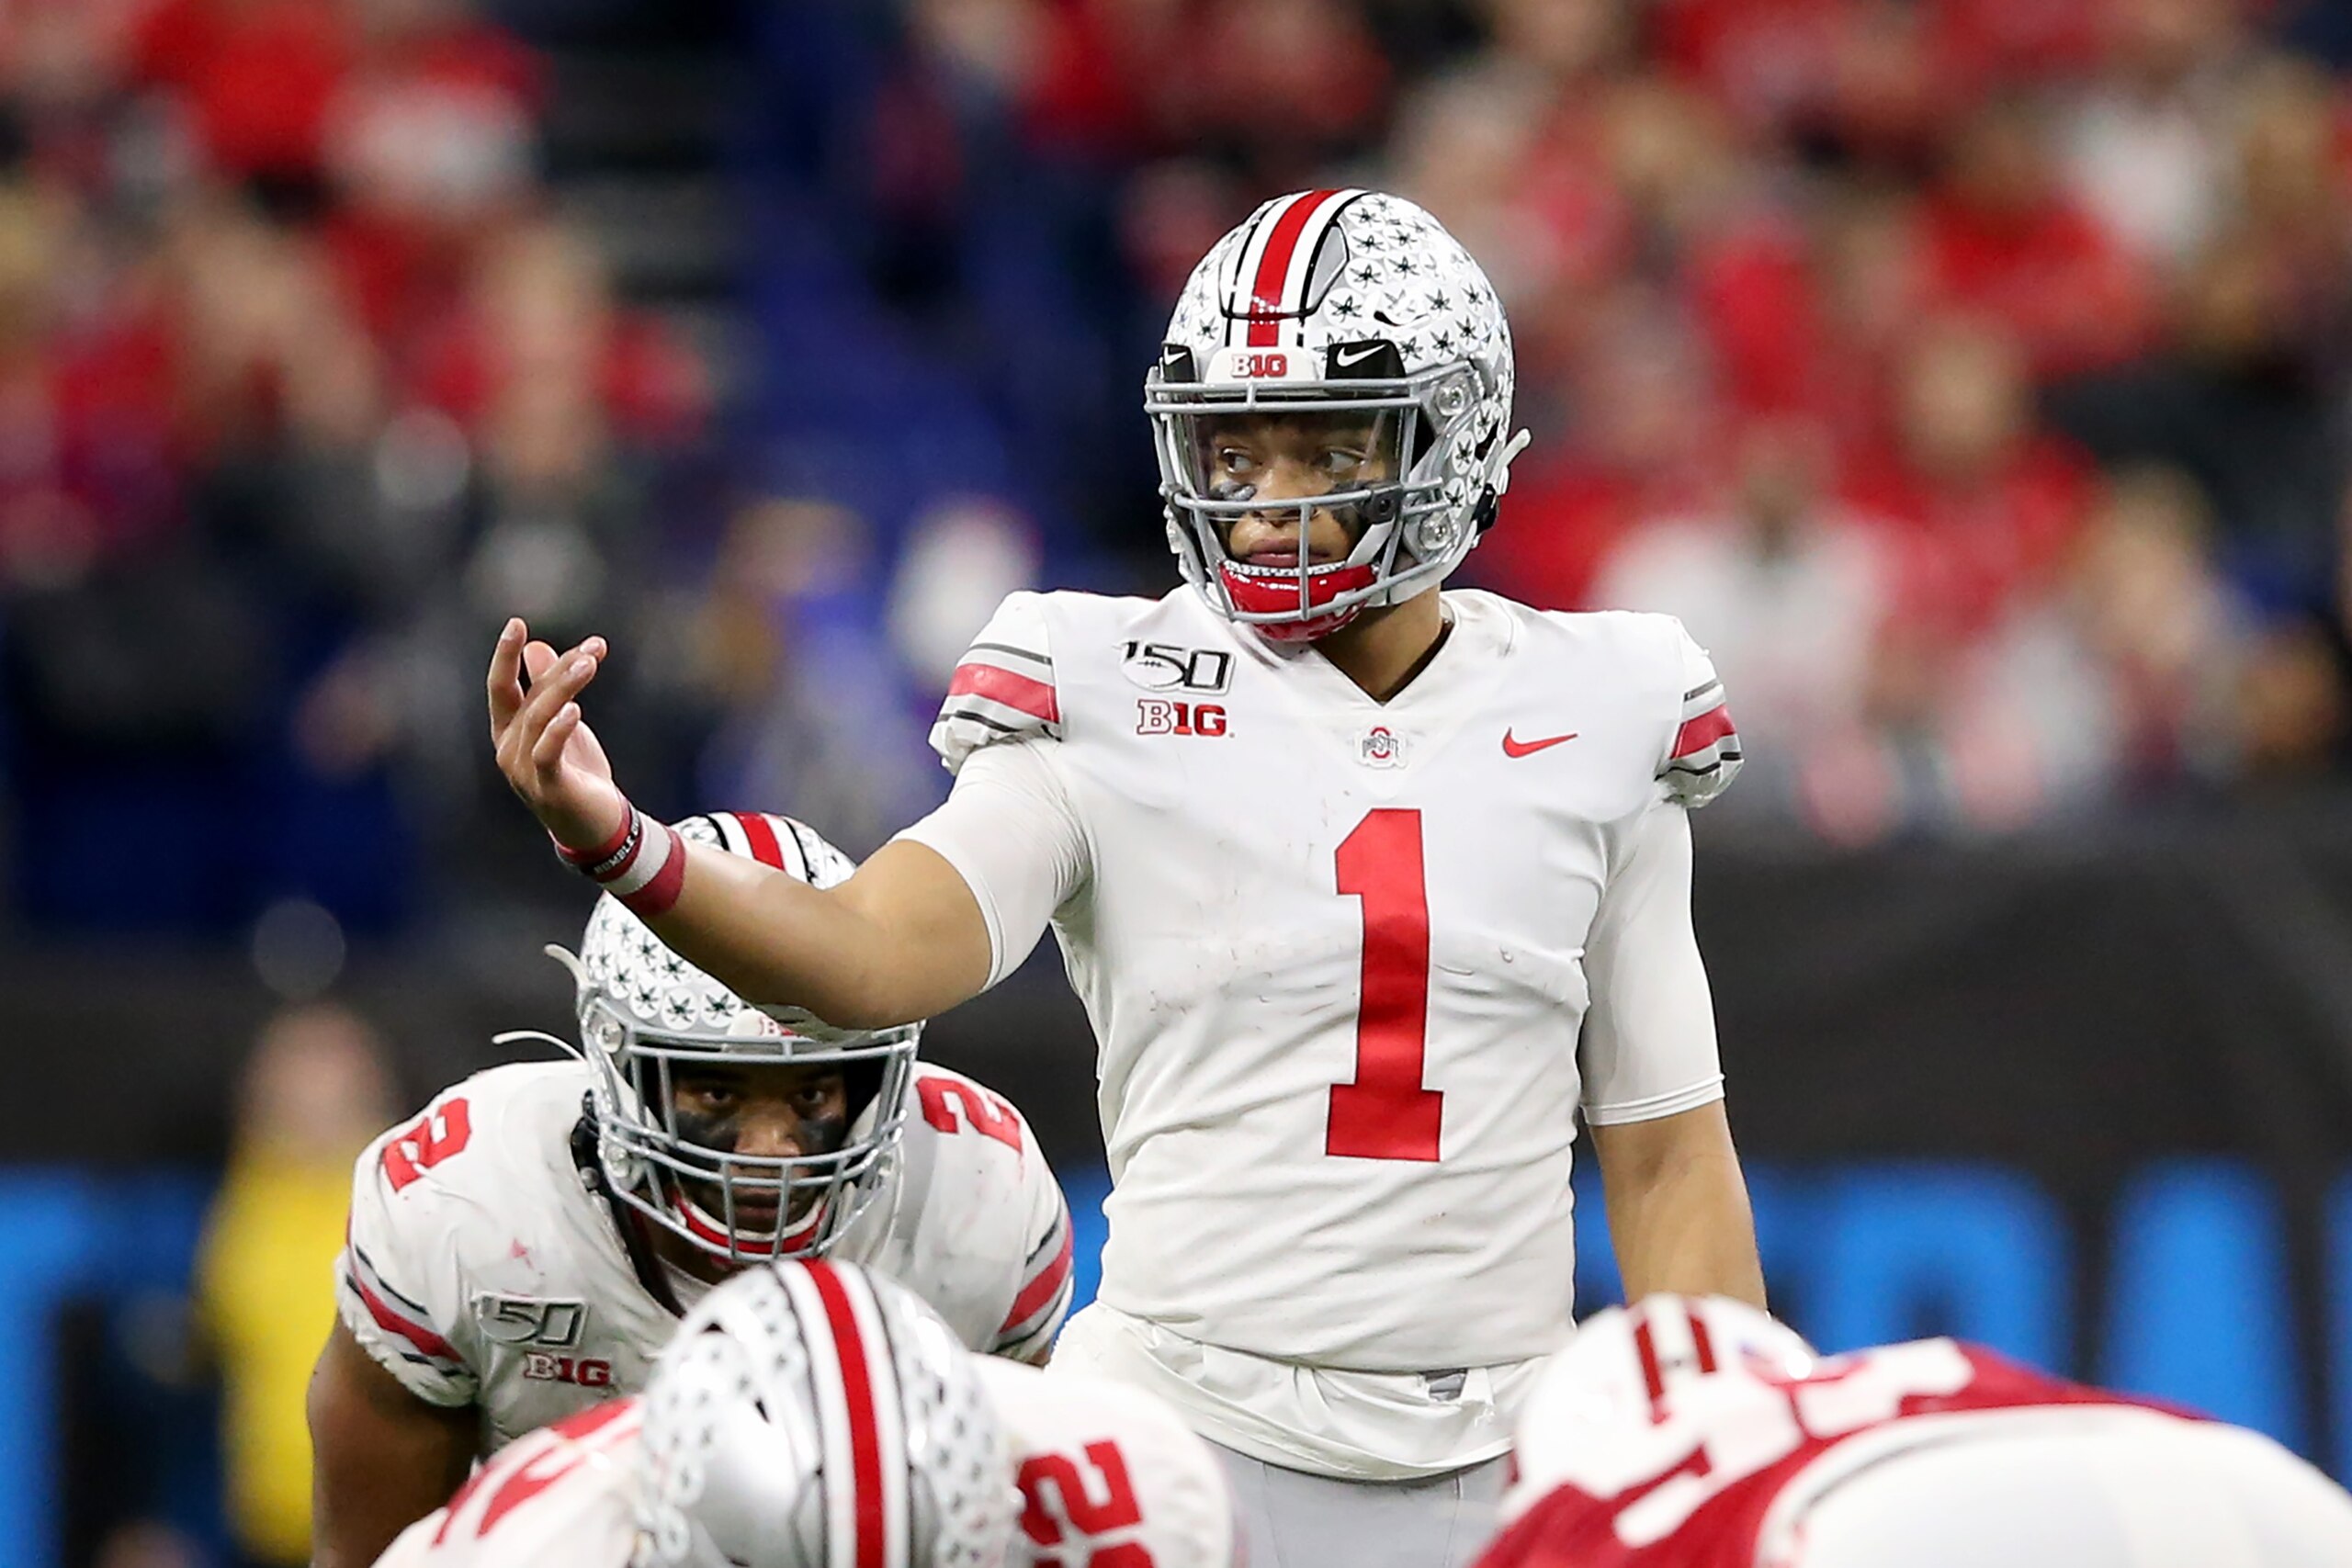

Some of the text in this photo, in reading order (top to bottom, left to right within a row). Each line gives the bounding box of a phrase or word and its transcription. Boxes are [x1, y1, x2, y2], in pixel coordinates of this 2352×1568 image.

[1125, 641, 1230, 690] 150
[1326, 808, 1443, 1161] 1
[382, 1098, 472, 1193] 2
[916, 1076, 1023, 1156] 2
